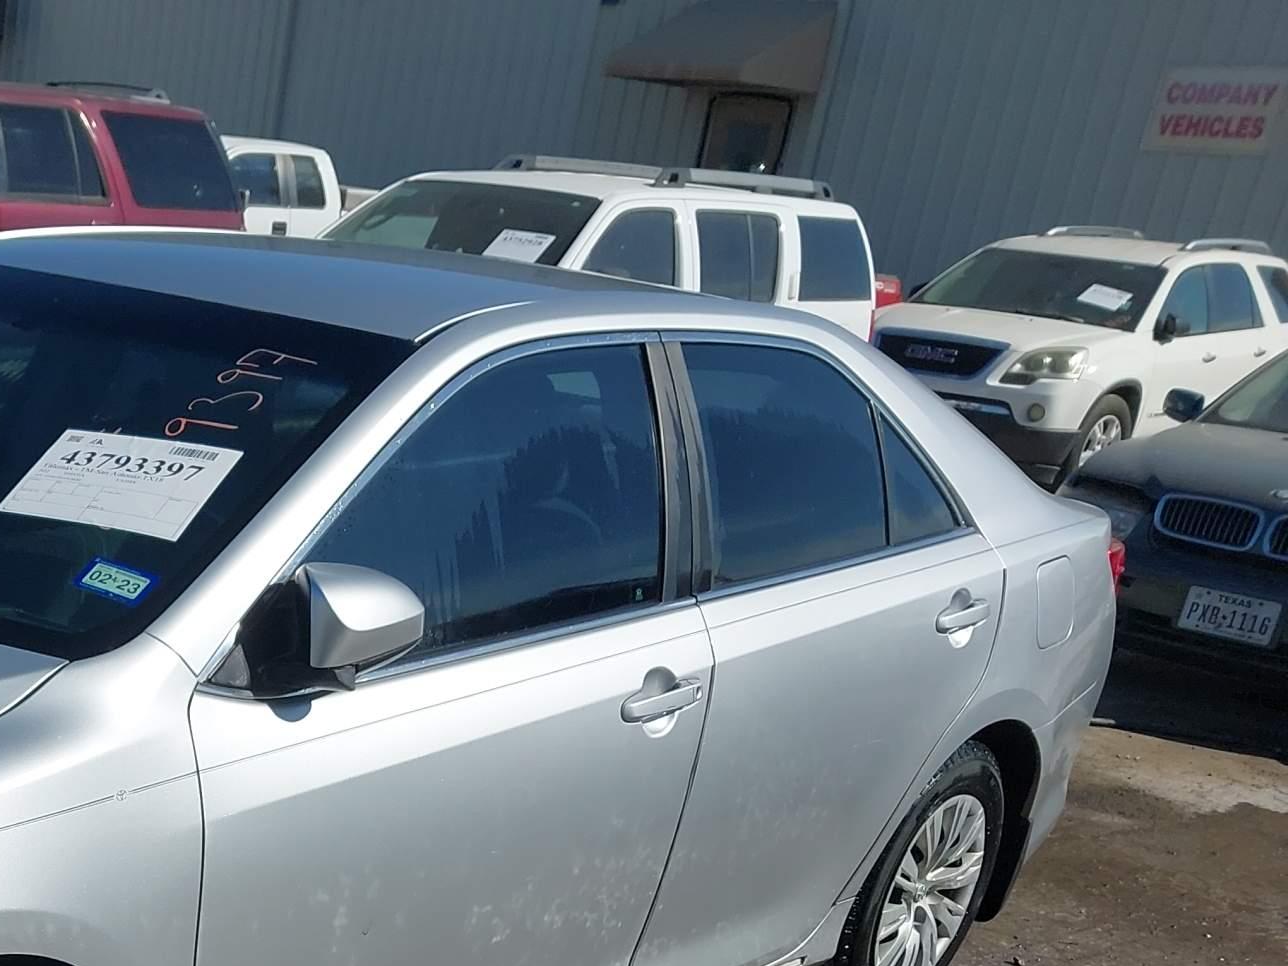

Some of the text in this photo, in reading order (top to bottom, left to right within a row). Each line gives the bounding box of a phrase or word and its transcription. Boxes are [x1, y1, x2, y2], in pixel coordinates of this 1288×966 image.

[1167, 82, 1278, 106] COMPANY
[1159, 113, 1265, 139] VEHICLES
[61, 449, 205, 481] 43793397
[1218, 594, 1252, 608] TEXAS
